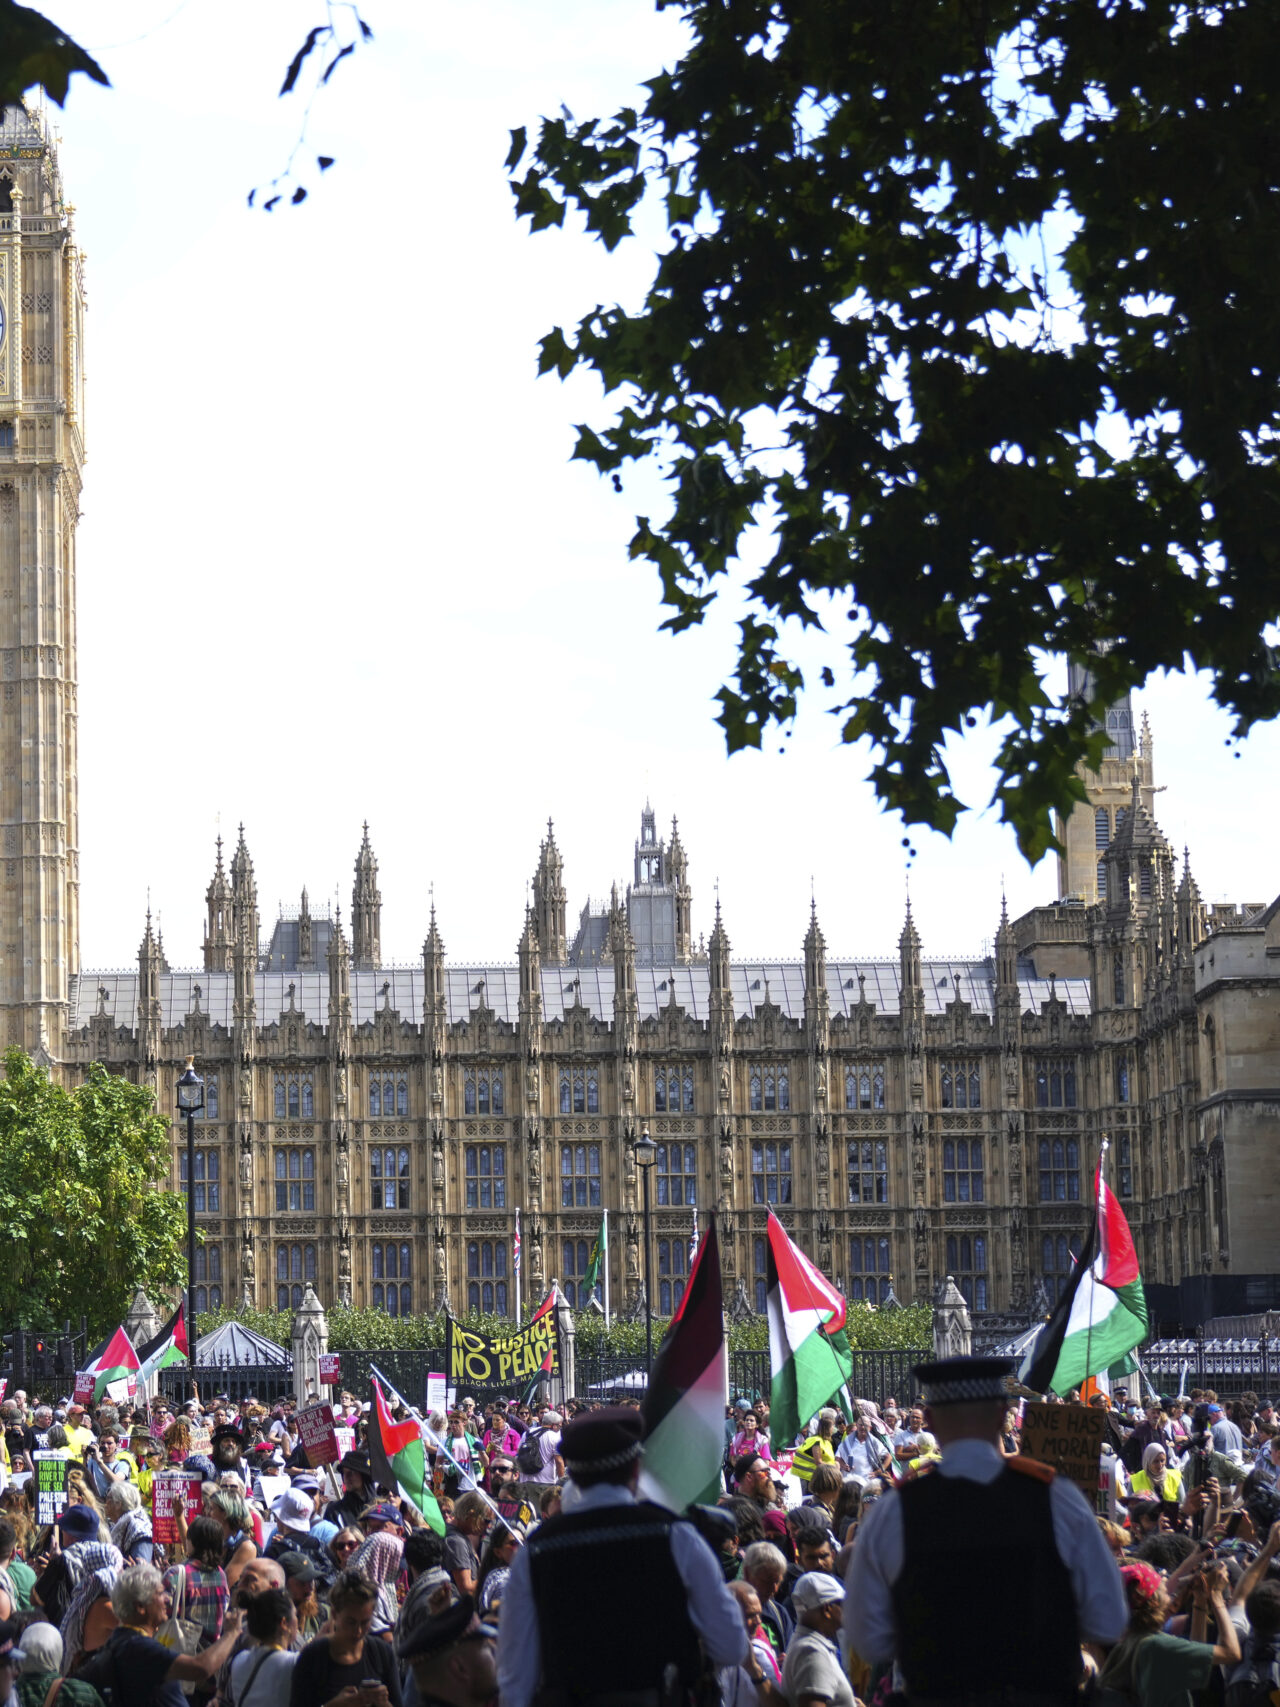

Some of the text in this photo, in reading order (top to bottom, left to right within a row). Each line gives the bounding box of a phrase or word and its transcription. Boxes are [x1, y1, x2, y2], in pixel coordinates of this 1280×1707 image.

[451, 1311, 557, 1354] NO JUSTICE
[451, 1338, 559, 1380] NO PEACE
[460, 1379, 487, 1387] BLACK
[1067, 1412, 1101, 1434] HAS
[1041, 1437, 1100, 1460] MORAL
[39, 1461, 57, 1471] FROM
[39, 1471, 65, 1482] RIVER TO
[39, 1482, 63, 1491] THE SEA
[155, 1481, 169, 1490] IT'S
[171, 1481, 184, 1490] NOT
[39, 1502, 63, 1513] WILL BE
[155, 1499, 168, 1508] ACT
[155, 1508, 189, 1517] GENOE
[498, 1502, 519, 1518] TOP
[39, 1513, 54, 1524] FREE
